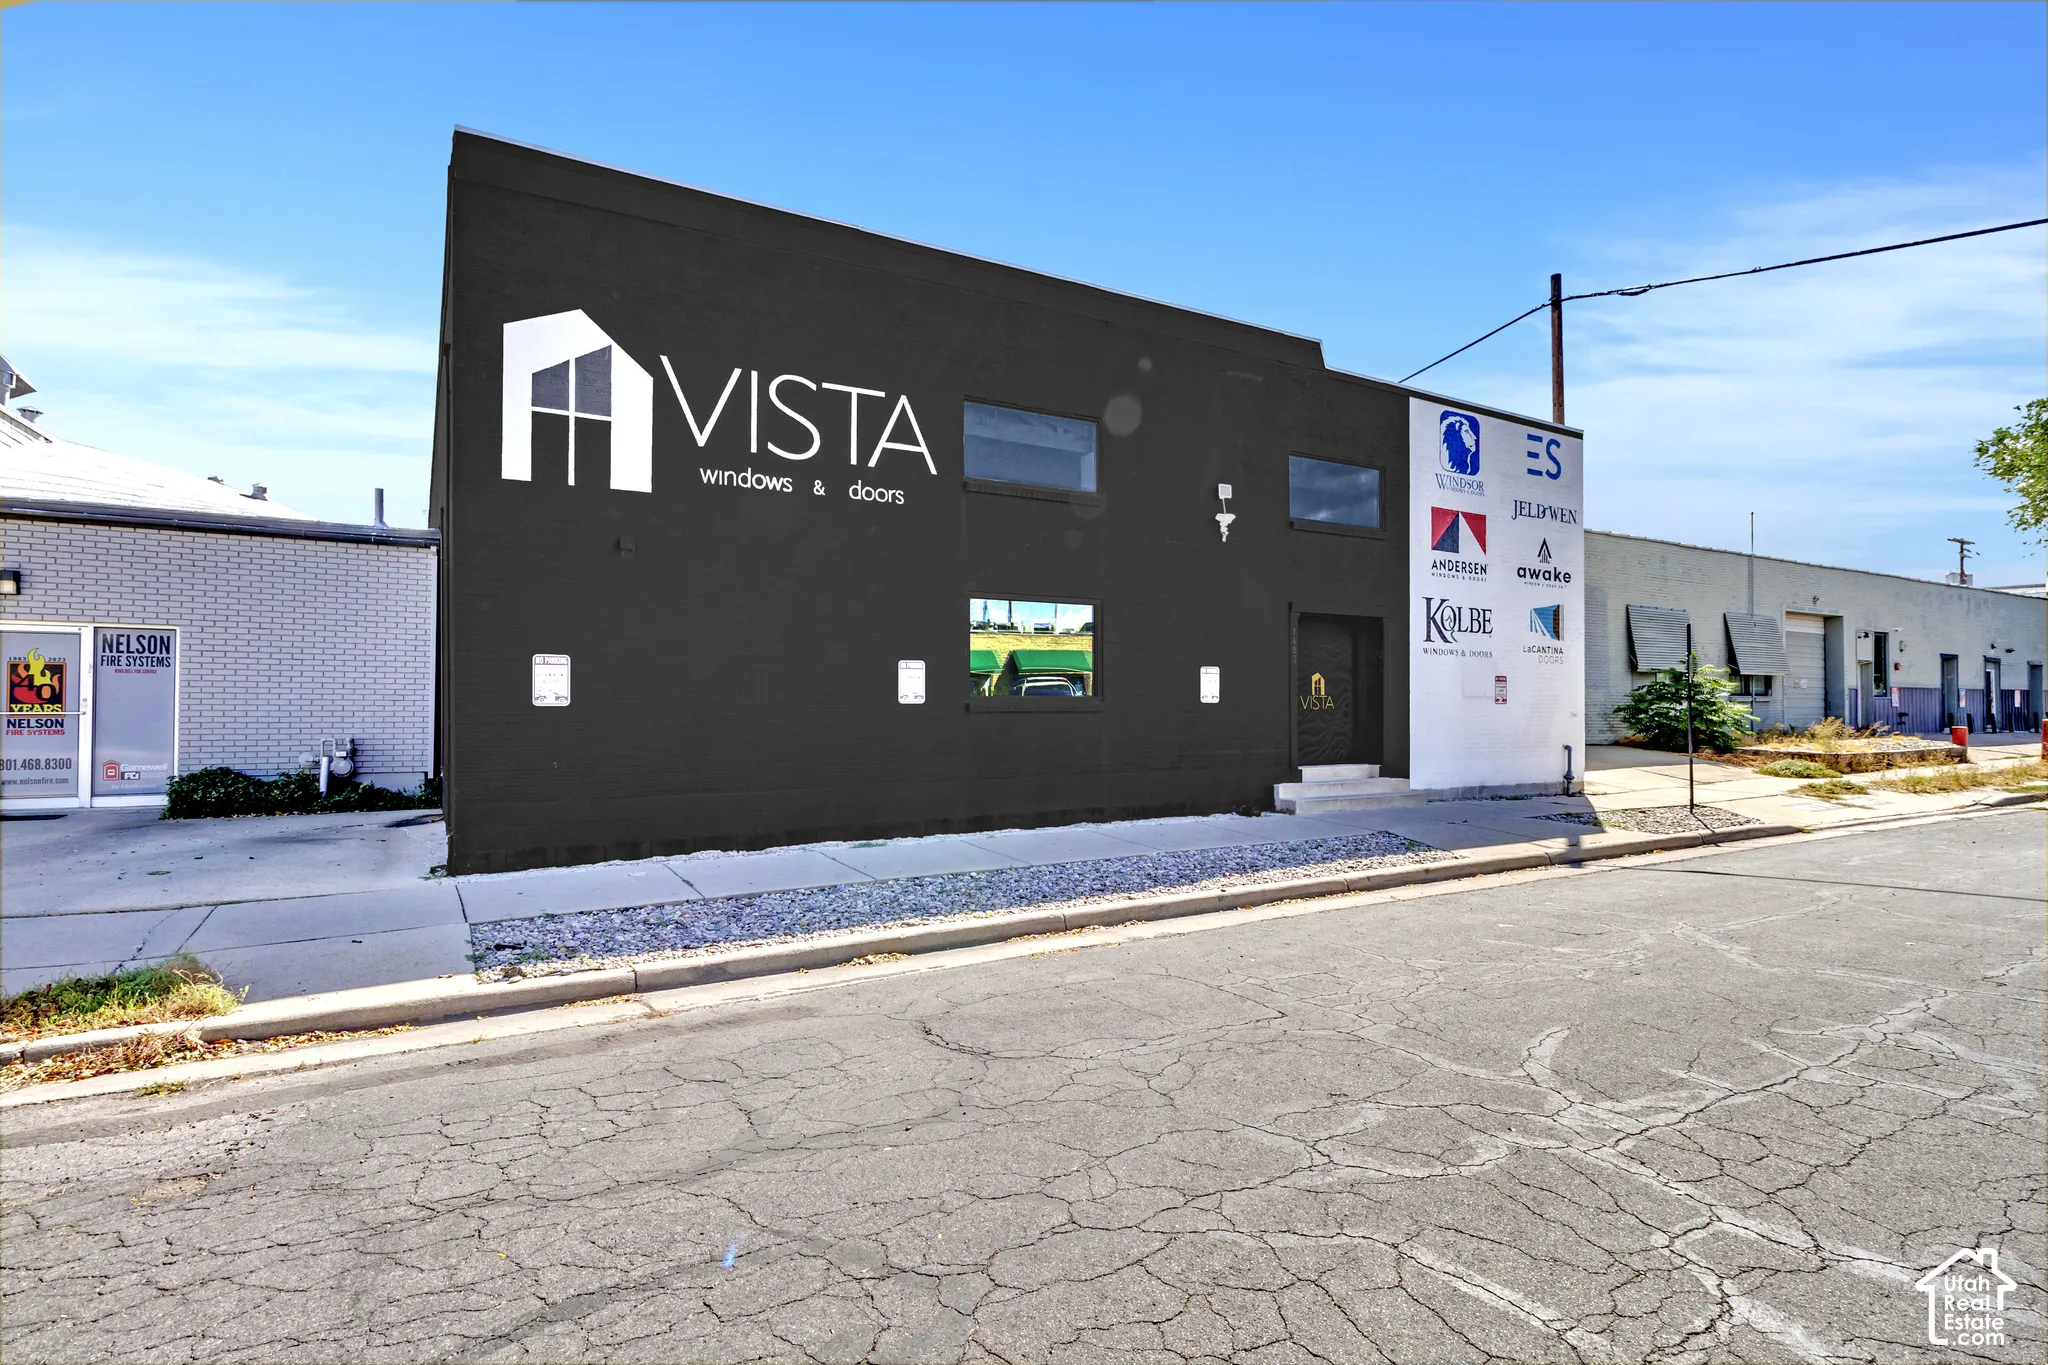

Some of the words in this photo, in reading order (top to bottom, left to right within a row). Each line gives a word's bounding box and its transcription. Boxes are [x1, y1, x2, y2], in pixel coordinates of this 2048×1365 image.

[660, 355, 937, 475] VISTA
[1527, 434, 1562, 480] ES
[700, 466, 792, 492] windows
[813, 480, 826, 496] &
[849, 480, 904, 504] doors
[1434, 473, 1484, 492] WINDSOR
[1432, 559, 1487, 576] ANDERSEN
[1516, 566, 1572, 584] awake
[1422, 596, 1494, 644] KOLBE
[102, 634, 170, 655] NELSON
[1522, 645, 1564, 654] LaCANTINA
[1423, 648, 1458, 656] WINDOWS
[1469, 650, 1492, 658] DOORS
[1538, 655, 1564, 664] DOORS
[101, 655, 122, 666] FIRE
[126, 656, 171, 668] SYSTEMS
[10, 704, 62, 712] YEARS
[1300, 695, 1335, 711] VISTA
[6, 718, 64, 728] NELSON
[0, 758, 72, 770] 801.468.8300
[1, 776, 69, 786] www.nelsonfire.com
